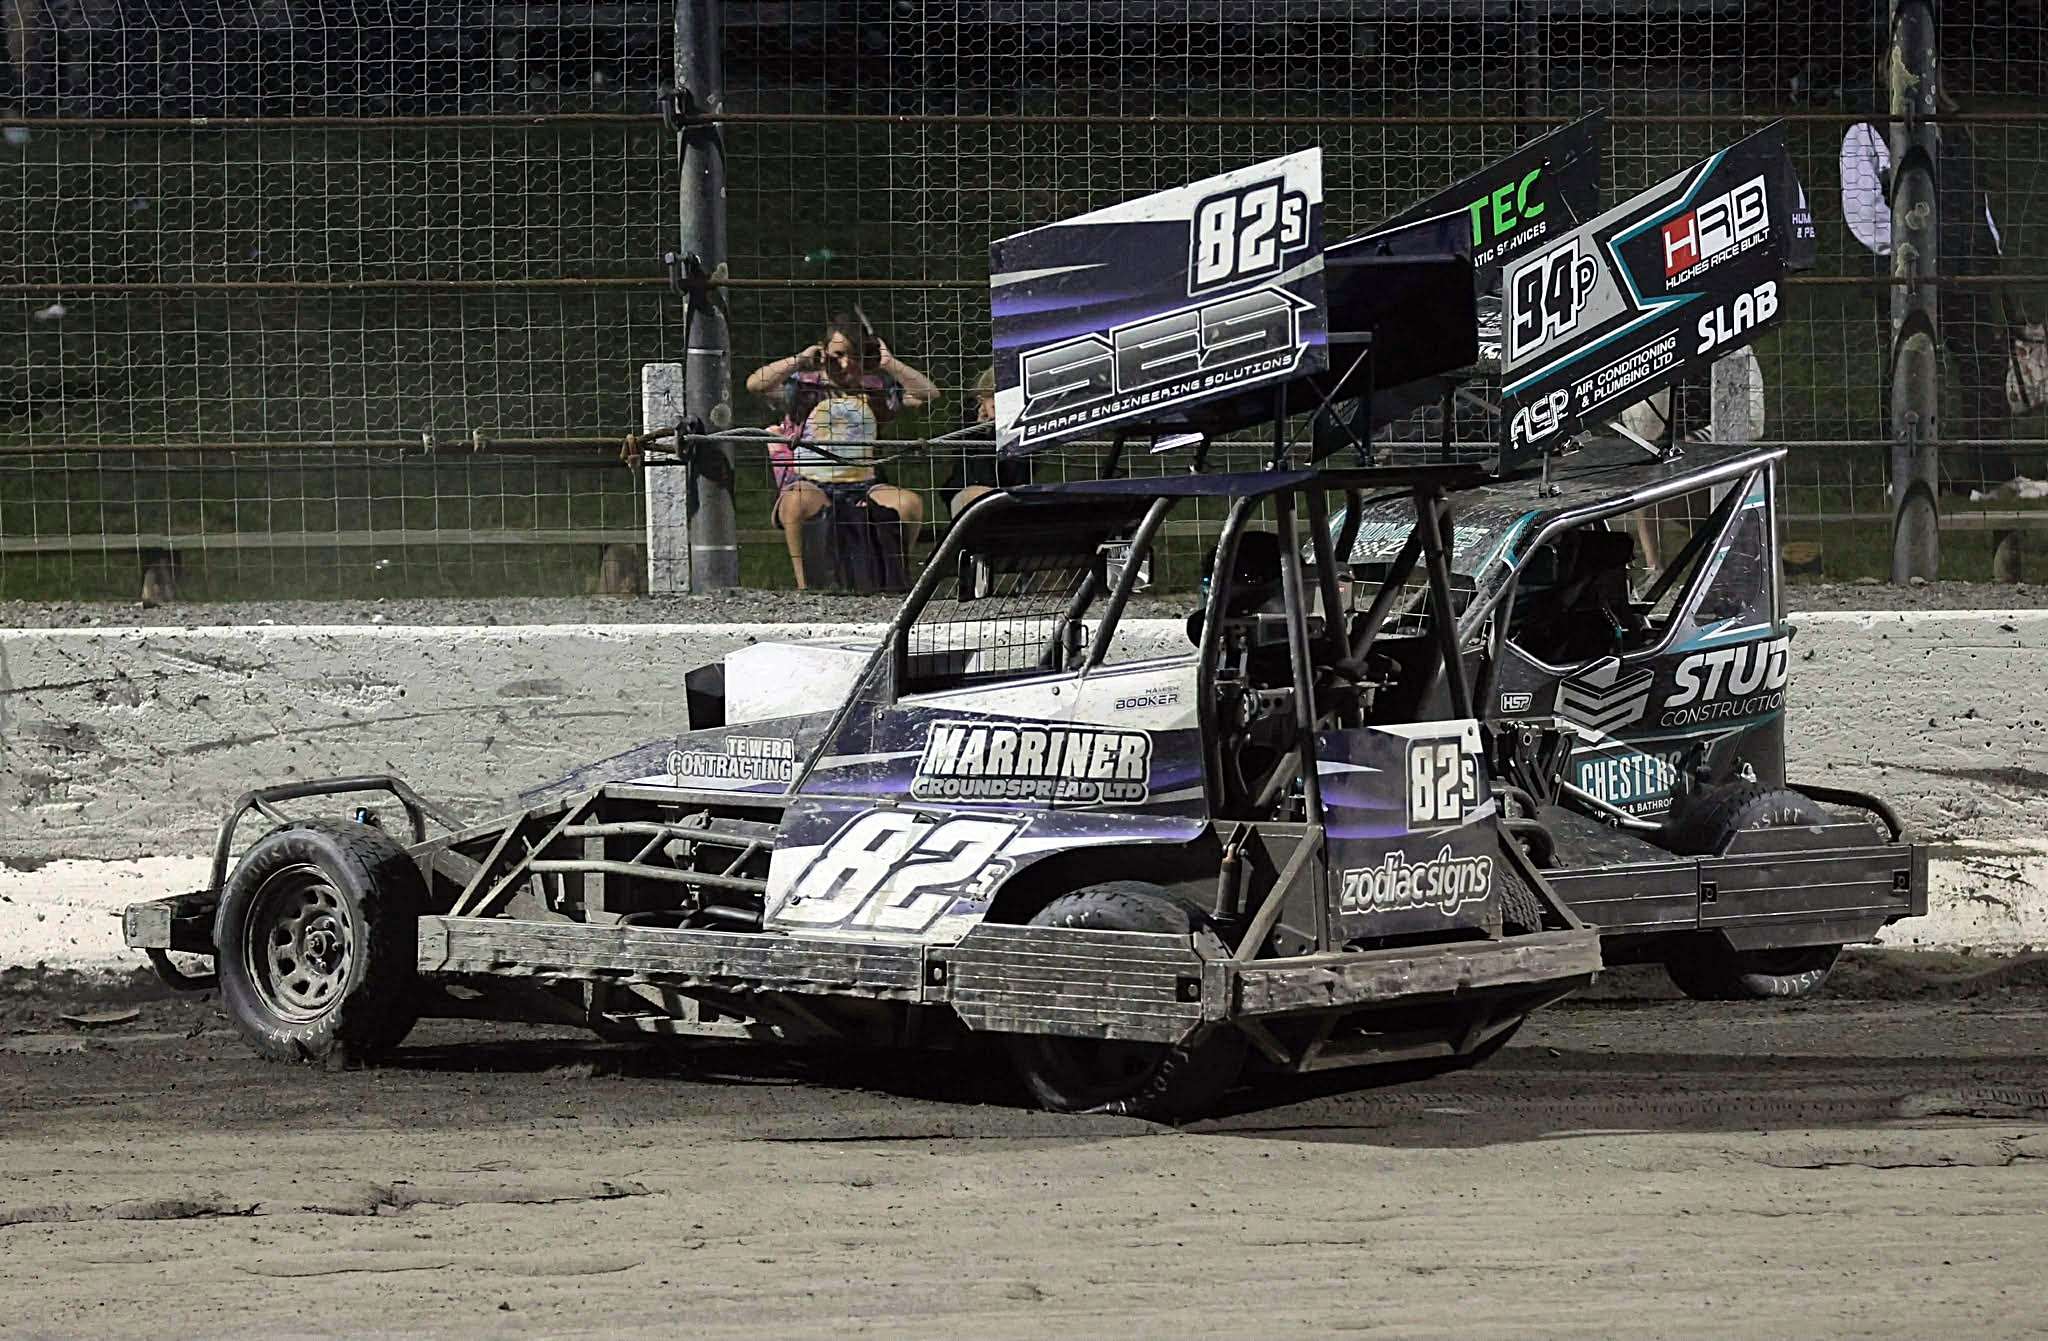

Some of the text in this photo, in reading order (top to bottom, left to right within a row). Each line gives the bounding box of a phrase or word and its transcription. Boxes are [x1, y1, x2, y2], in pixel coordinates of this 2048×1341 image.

[1469, 168, 1545, 247] TEC
[1662, 178, 1768, 270] HRB
[1665, 227, 1770, 291] HUGHES RACE BUILT
[1696, 280, 1779, 355] SLAB
[1027, 354, 1293, 436] SHARPE ENGINEERING SOLUTIONS
[1574, 336, 1677, 399] AIR CONDITIONING
[1581, 351, 1673, 408] & PLUMBING LTD
[1115, 693, 1178, 709] BOOKER
[1663, 636, 1789, 708] STUD
[668, 752, 792, 781] CONTRACTING
[727, 738, 792, 759] TE WERA
[922, 726, 1146, 779] MARRINER
[914, 777, 1145, 799] GROUNDSPREAD LTD
[1426, 847, 1488, 906] signs
